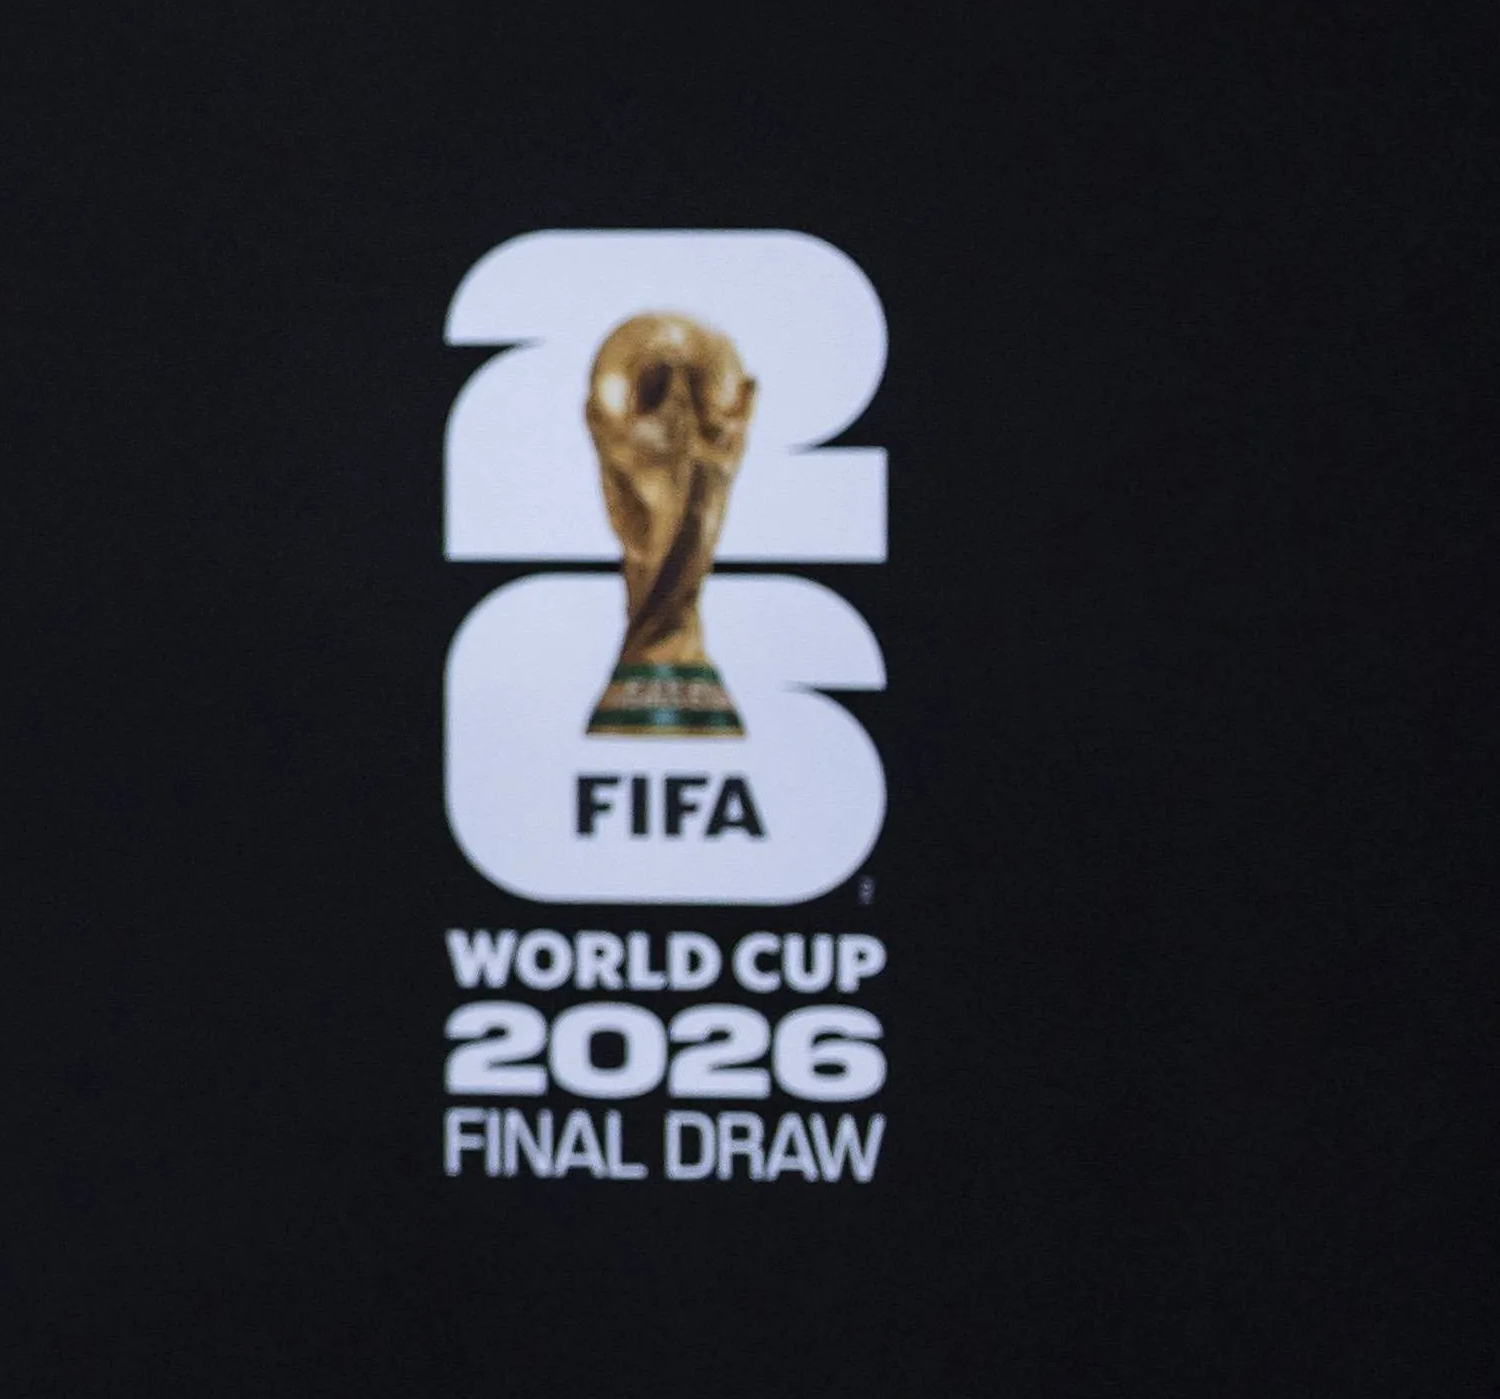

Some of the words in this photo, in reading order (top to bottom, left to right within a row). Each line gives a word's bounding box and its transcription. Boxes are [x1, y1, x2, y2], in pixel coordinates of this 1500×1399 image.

[574, 774, 766, 840] FIFA
[446, 928, 723, 992] WORLD
[733, 931, 887, 994] CUP
[444, 1000, 887, 1103] 2026
[444, 1106, 649, 1181] FINAL
[664, 1109, 887, 1183] DRAW
